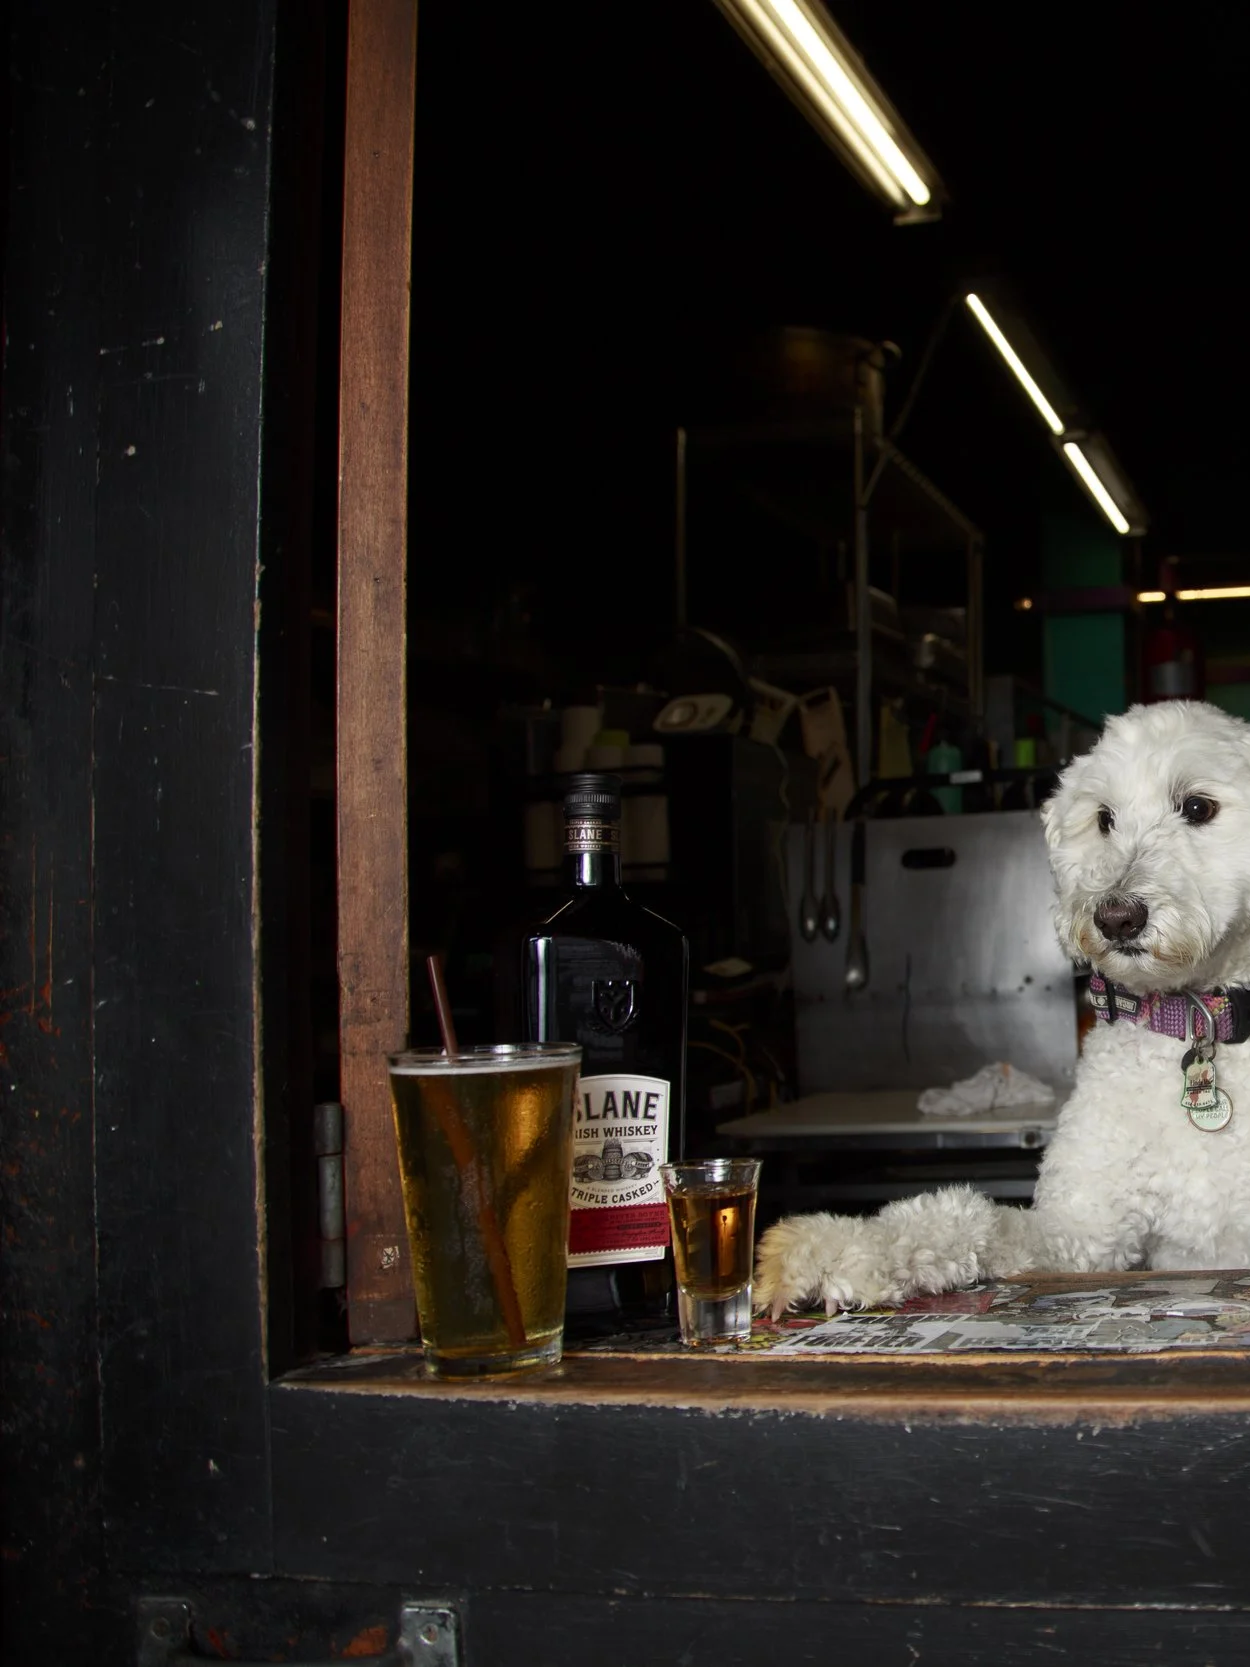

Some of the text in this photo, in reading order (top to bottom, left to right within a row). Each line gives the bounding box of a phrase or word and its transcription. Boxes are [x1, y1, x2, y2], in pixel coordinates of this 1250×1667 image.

[569, 829, 603, 840] SLANE
[603, 1125, 658, 1138] WHISKEY
[571, 1183, 654, 1204] TRIPLE CASKED
